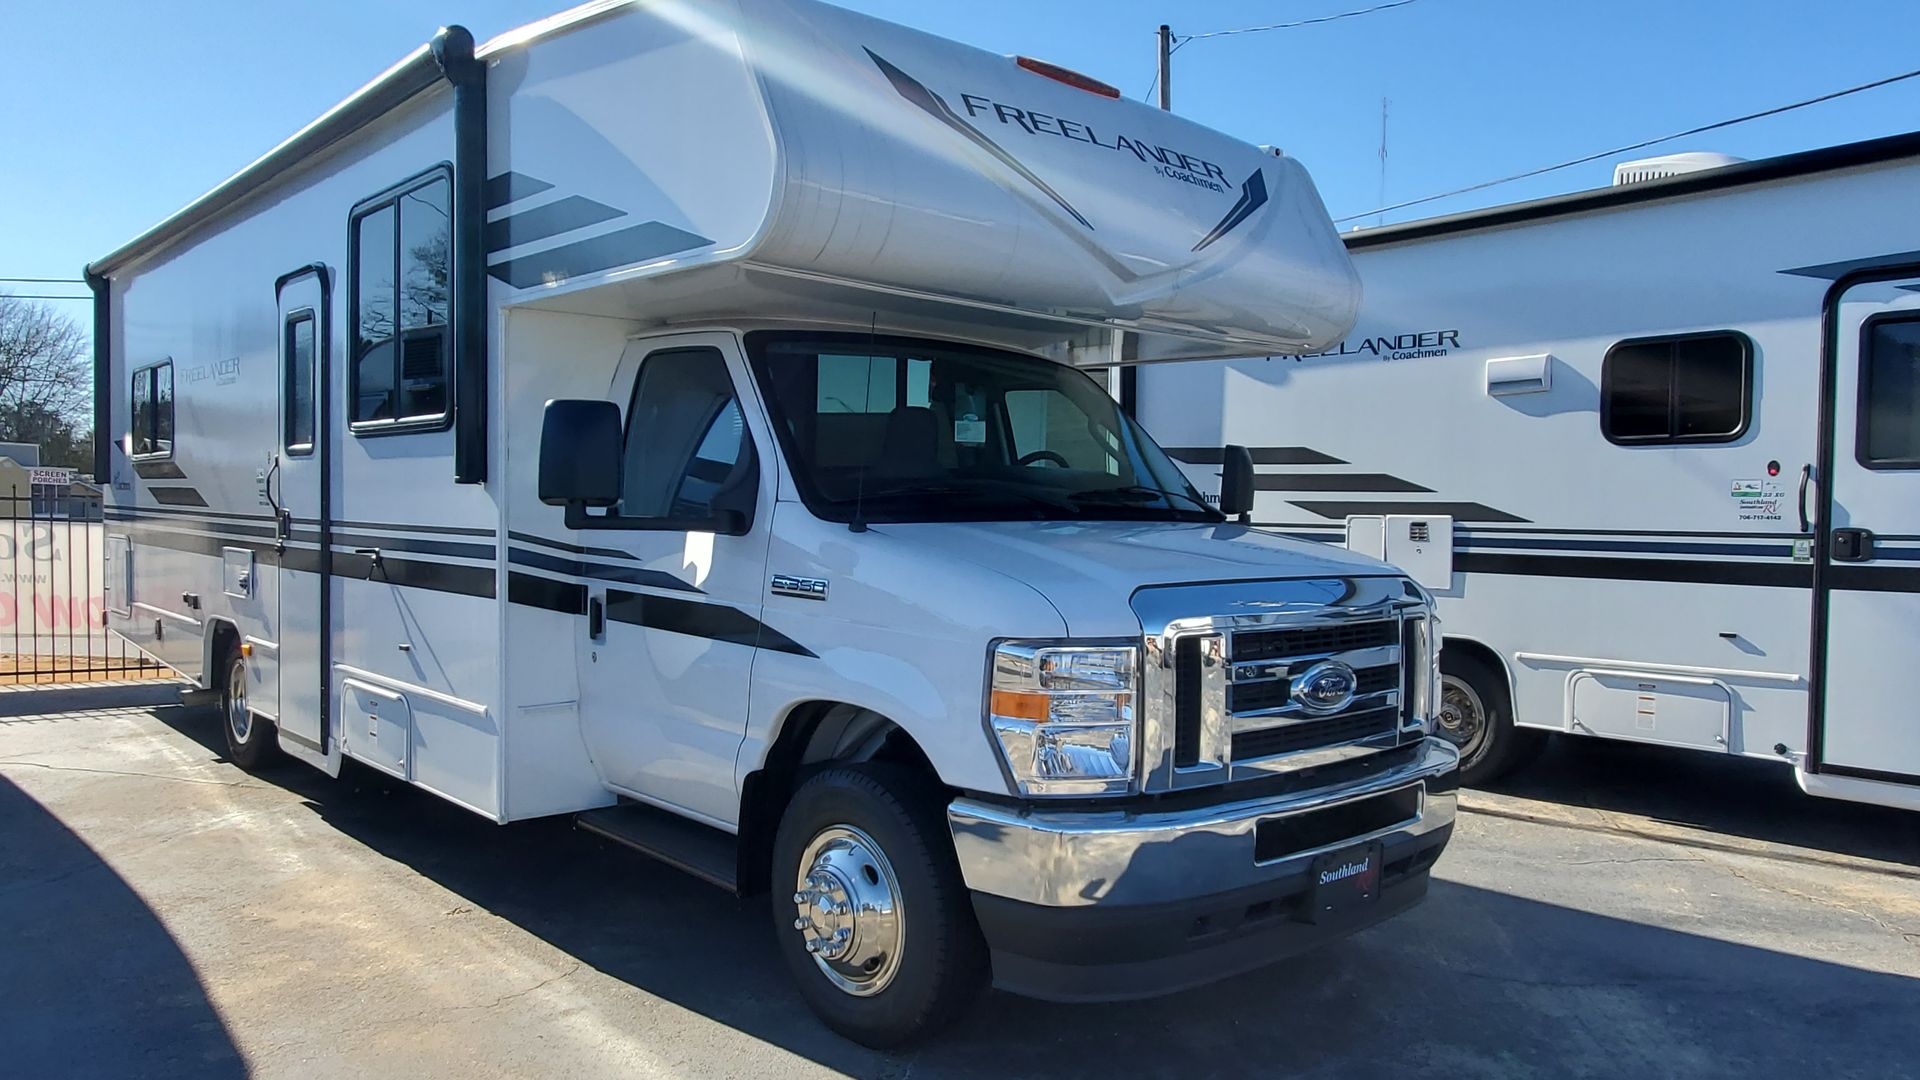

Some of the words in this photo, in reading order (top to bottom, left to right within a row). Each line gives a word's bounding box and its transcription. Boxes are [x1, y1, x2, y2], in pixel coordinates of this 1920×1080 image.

[960, 93, 1233, 189] FREELANDER
[1154, 166, 1165, 178] By
[1163, 166, 1225, 194] Coachmen
[1266, 329, 1461, 362] LANDER
[1391, 348, 1448, 361] Coachmen
[33, 470, 67, 478] SCREEN
[1318, 677, 1346, 698] Ford
[1319, 856, 1369, 885] Southland
